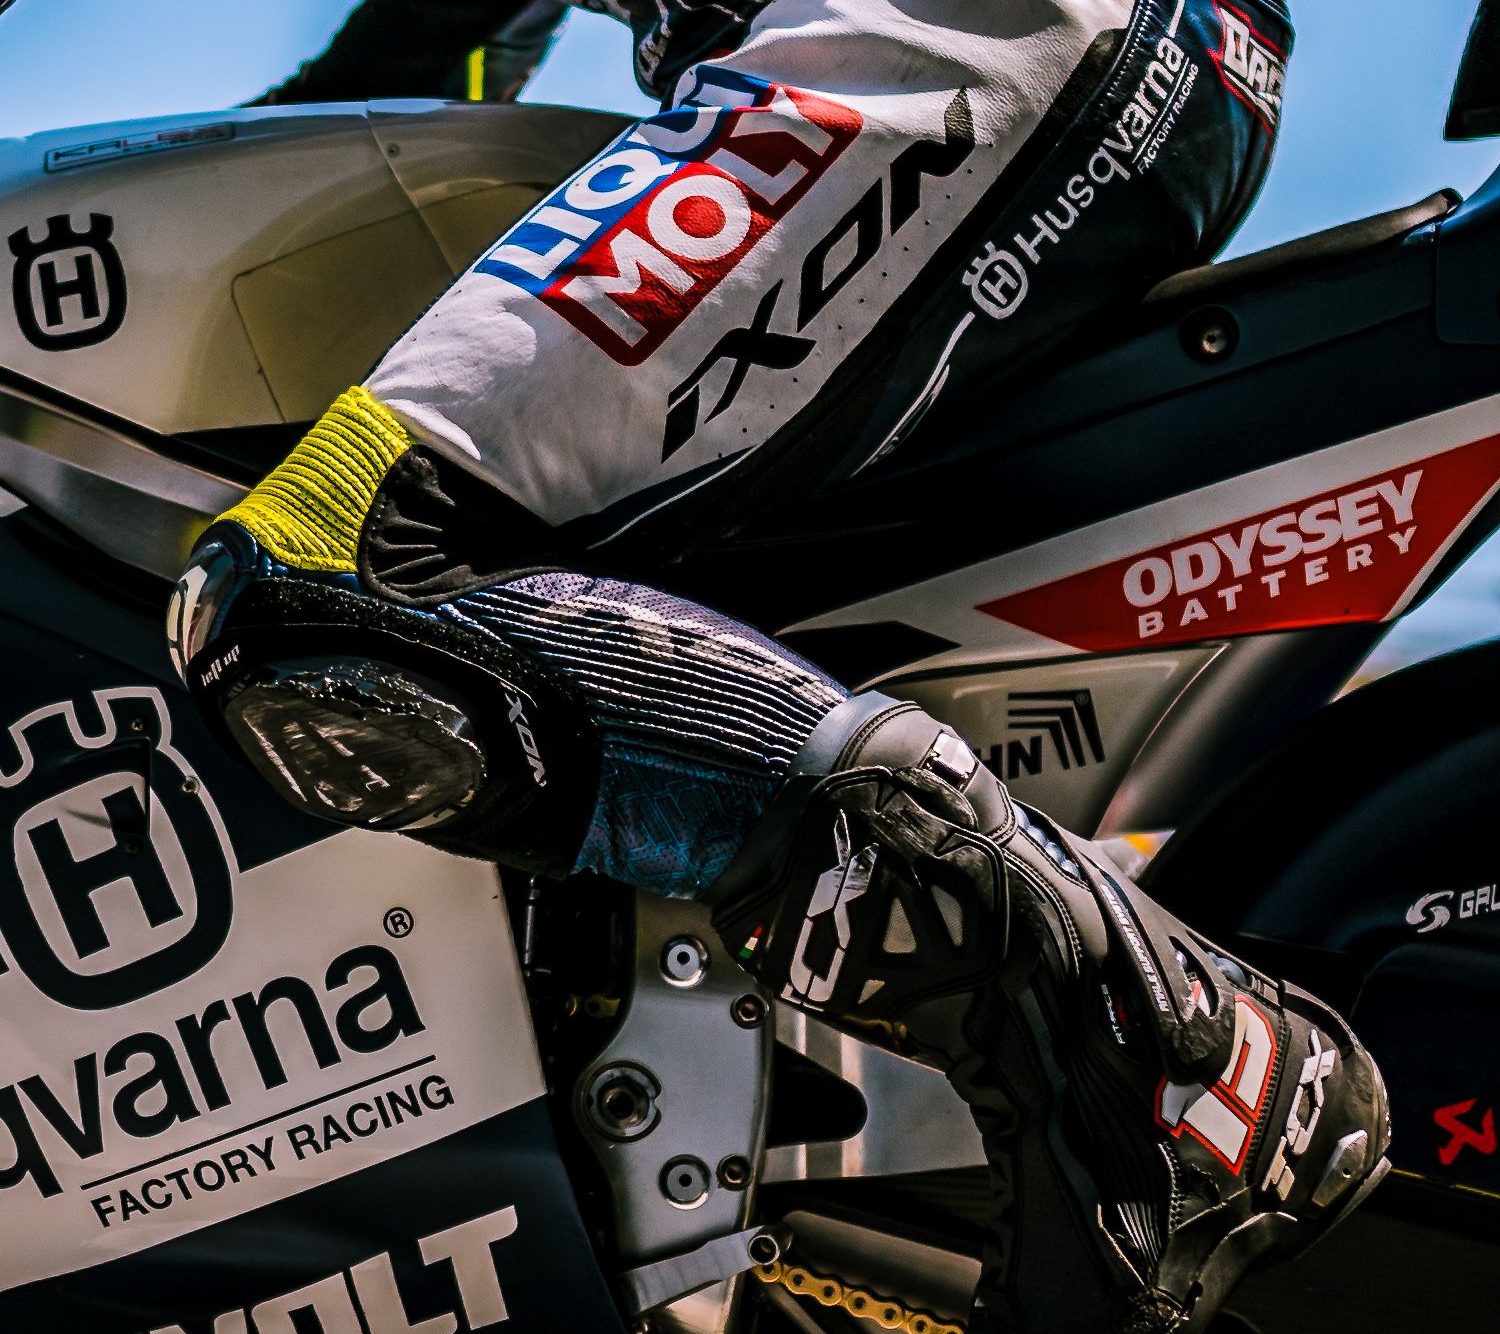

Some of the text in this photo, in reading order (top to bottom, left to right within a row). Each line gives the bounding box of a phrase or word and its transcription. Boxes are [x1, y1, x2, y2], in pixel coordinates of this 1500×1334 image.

[1014, 37, 1184, 264] Husqvarna
[1138, 63, 1199, 175] FACTORY RACING
[562, 85, 837, 347] MOLY
[1123, 470, 1424, 608] ODYSSEY
[1138, 526, 1418, 640] BATTERY
[89, 1073, 455, 1228] FACTORY RACING
